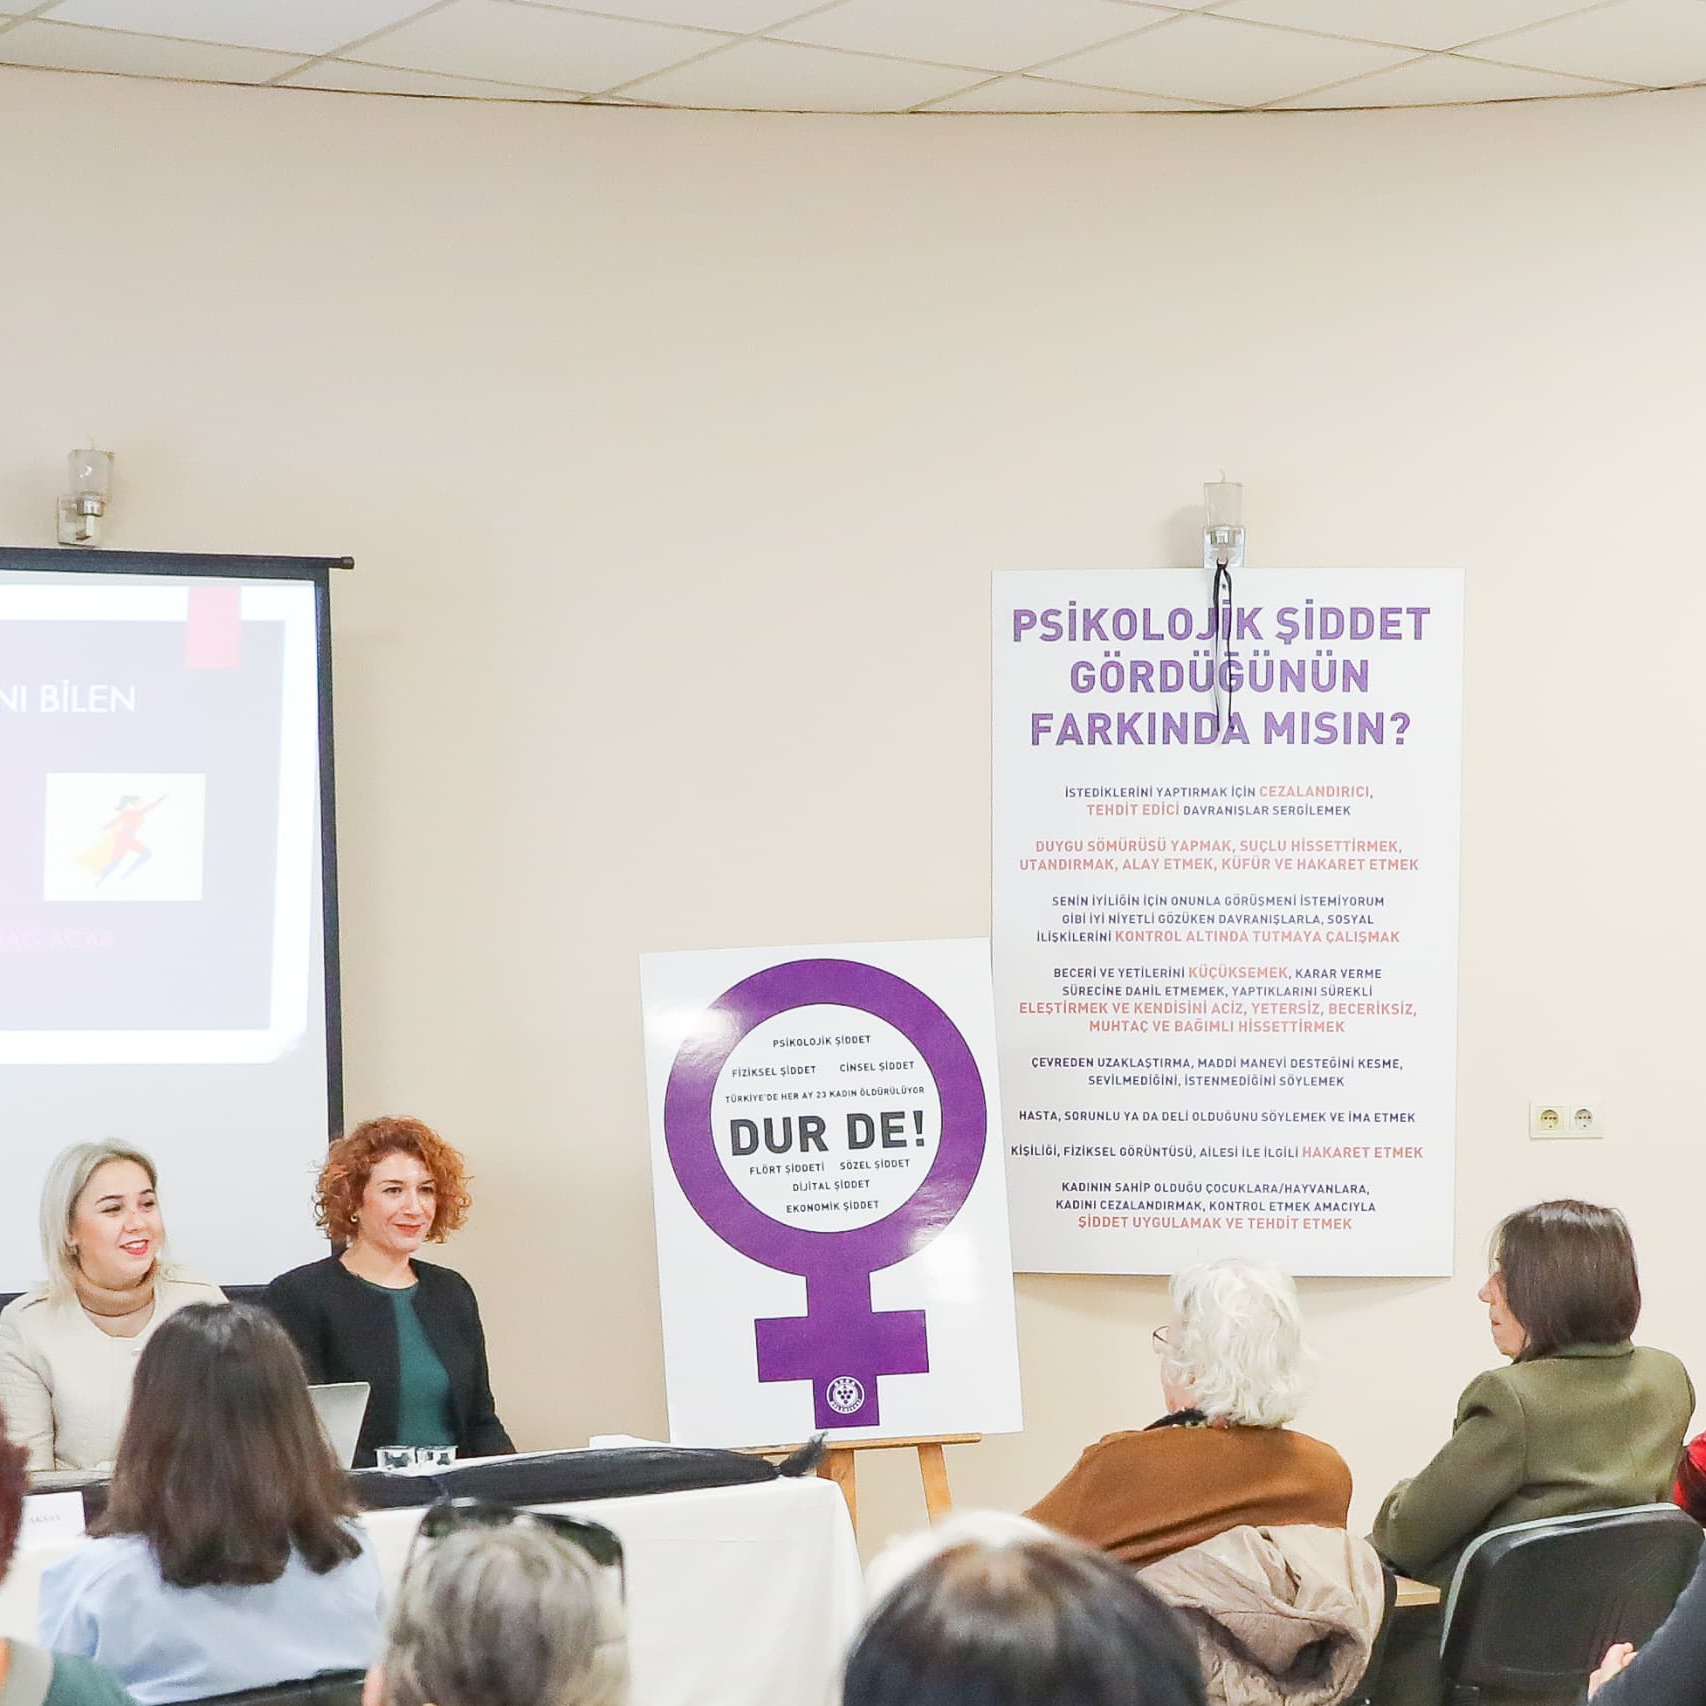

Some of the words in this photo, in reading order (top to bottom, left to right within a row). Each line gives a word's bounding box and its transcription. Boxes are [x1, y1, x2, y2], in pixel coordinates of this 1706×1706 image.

[1276, 599, 1430, 645] ŞİDDET
[41, 680, 134, 712] BİLEN
[1264, 712, 1410, 745] MISIN?
[1066, 786, 1152, 798] İSTEDİKLERİNİ
[1157, 787, 1227, 797] YAPTIRMAK
[1232, 785, 1255, 798] İÇİN
[1260, 786, 1373, 799] CEZALANDIRICI,
[1087, 802, 1138, 816] TEHDİT
[1143, 801, 1179, 815] EDİCİ
[1184, 806, 1269, 816] DAVRANIŞLAR
[1273, 804, 1350, 815] SERGİLEMEK
[1036, 840, 1083, 852] DUYGU
[1087, 837, 1166, 852] SÖMÜRÜSÜ
[1171, 840, 1236, 856] YAPMAK,
[1240, 840, 1286, 856] SUÇLU
[1292, 838, 1402, 853] HİSSETTİRMEK,
[773, 1037, 831, 1047] PSİKOLOJİK
[835, 1035, 870, 1046] ŞİDDET
[733, 1068, 777, 1077] FİZİKSEL
[781, 1066, 816, 1077] ŞİDDET
[840, 1062, 875, 1072] CİNSEL
[879, 1061, 914, 1072] ŞİDDET
[730, 1116, 829, 1156] DUR
[847, 1110, 925, 1151] DE!
[1011, 1144, 1060, 1157] KİŞİLİĞİ,
[1064, 1144, 1116, 1156] FİZİKSEL
[1120, 1145, 1196, 1158] GÖRÜNTÜSÜ,
[1200, 1146, 1237, 1157] AİLESİ
[1242, 1146, 1260, 1157] İLE
[1265, 1146, 1298, 1158] İLGİLİ
[1303, 1147, 1369, 1158] HAKARET
[1375, 1147, 1422, 1158] ETMEK
[750, 1165, 781, 1175] FLÖRT
[785, 1162, 824, 1173] ŞİDDETİ
[840, 1160, 871, 1170] SÖZEL
[875, 1159, 909, 1170] ŞİDDET
[793, 1181, 830, 1191] DİJİTAL
[834, 1180, 869, 1190] ŞİDDET
[787, 1202, 839, 1213] EKONOMİK
[843, 1200, 878, 1212] ŞİDDET
[1056, 1200, 1096, 1209] KADINI
[1100, 1200, 1205, 1212] CEZALANDIRMAK,
[1210, 1201, 1265, 1211] KONTROL
[1270, 1202, 1310, 1211] ETMEK
[1314, 1202, 1375, 1211] AMACIYLA
[1078, 1213, 1129, 1229] ŞİDDET
[1133, 1217, 1221, 1228] UYGULAMAK
[1226, 1218, 1243, 1229] VE
[1248, 1215, 1299, 1229] TEHDİT
[1303, 1218, 1351, 1229] ETMEK
